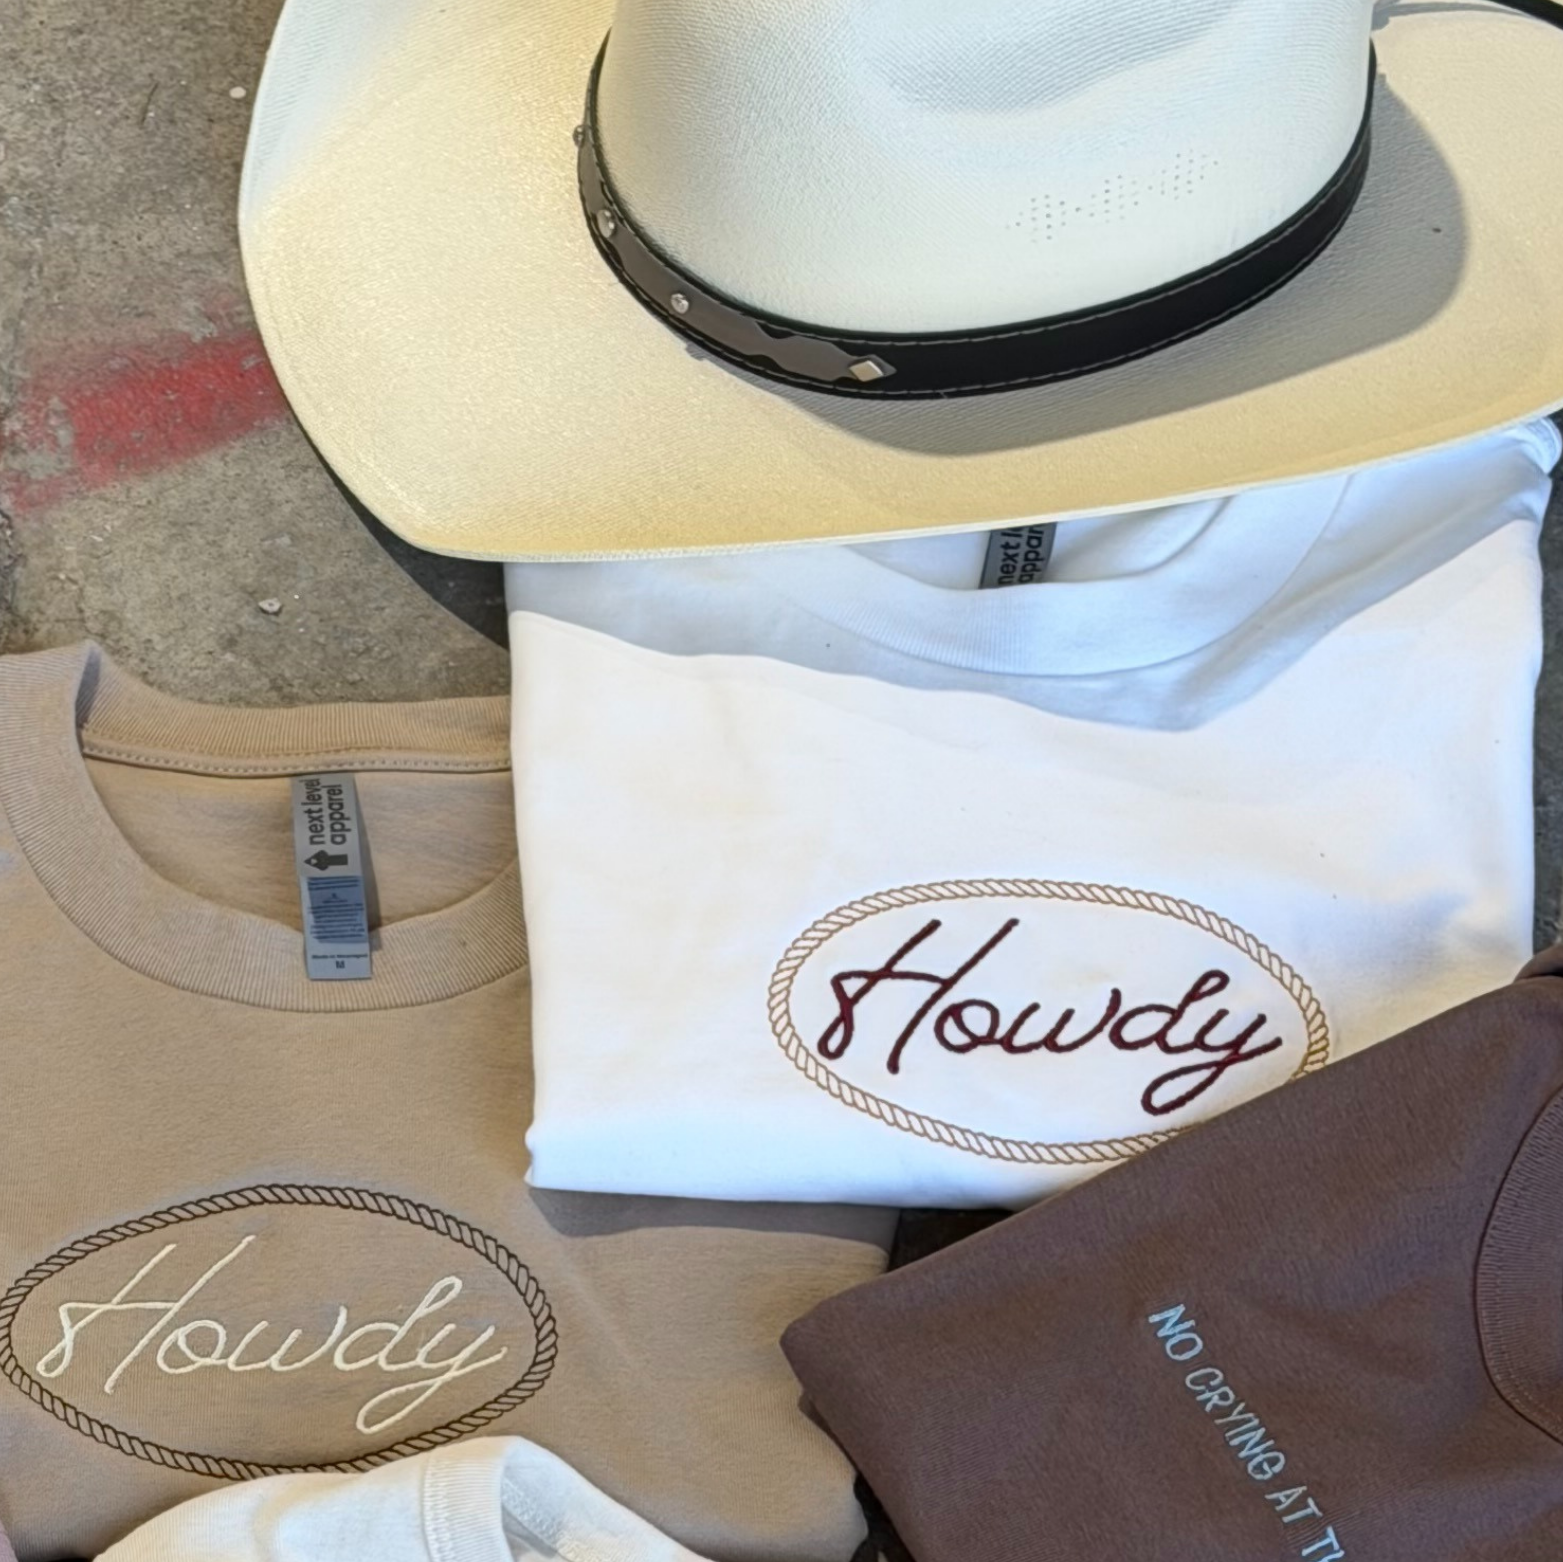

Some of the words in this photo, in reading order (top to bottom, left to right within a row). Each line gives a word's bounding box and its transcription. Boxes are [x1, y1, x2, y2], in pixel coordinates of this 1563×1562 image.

[998, 541, 1021, 585] next
[299, 778, 322, 806] level
[320, 784, 352, 846] apparel
[302, 807, 326, 846] next
[817, 917, 1284, 1116] Howdy
[36, 1234, 508, 1435] Howdy
[1148, 1303, 1204, 1361] NO
[1184, 1367, 1286, 1481] CRYING
[1264, 1485, 1323, 1524] AT
